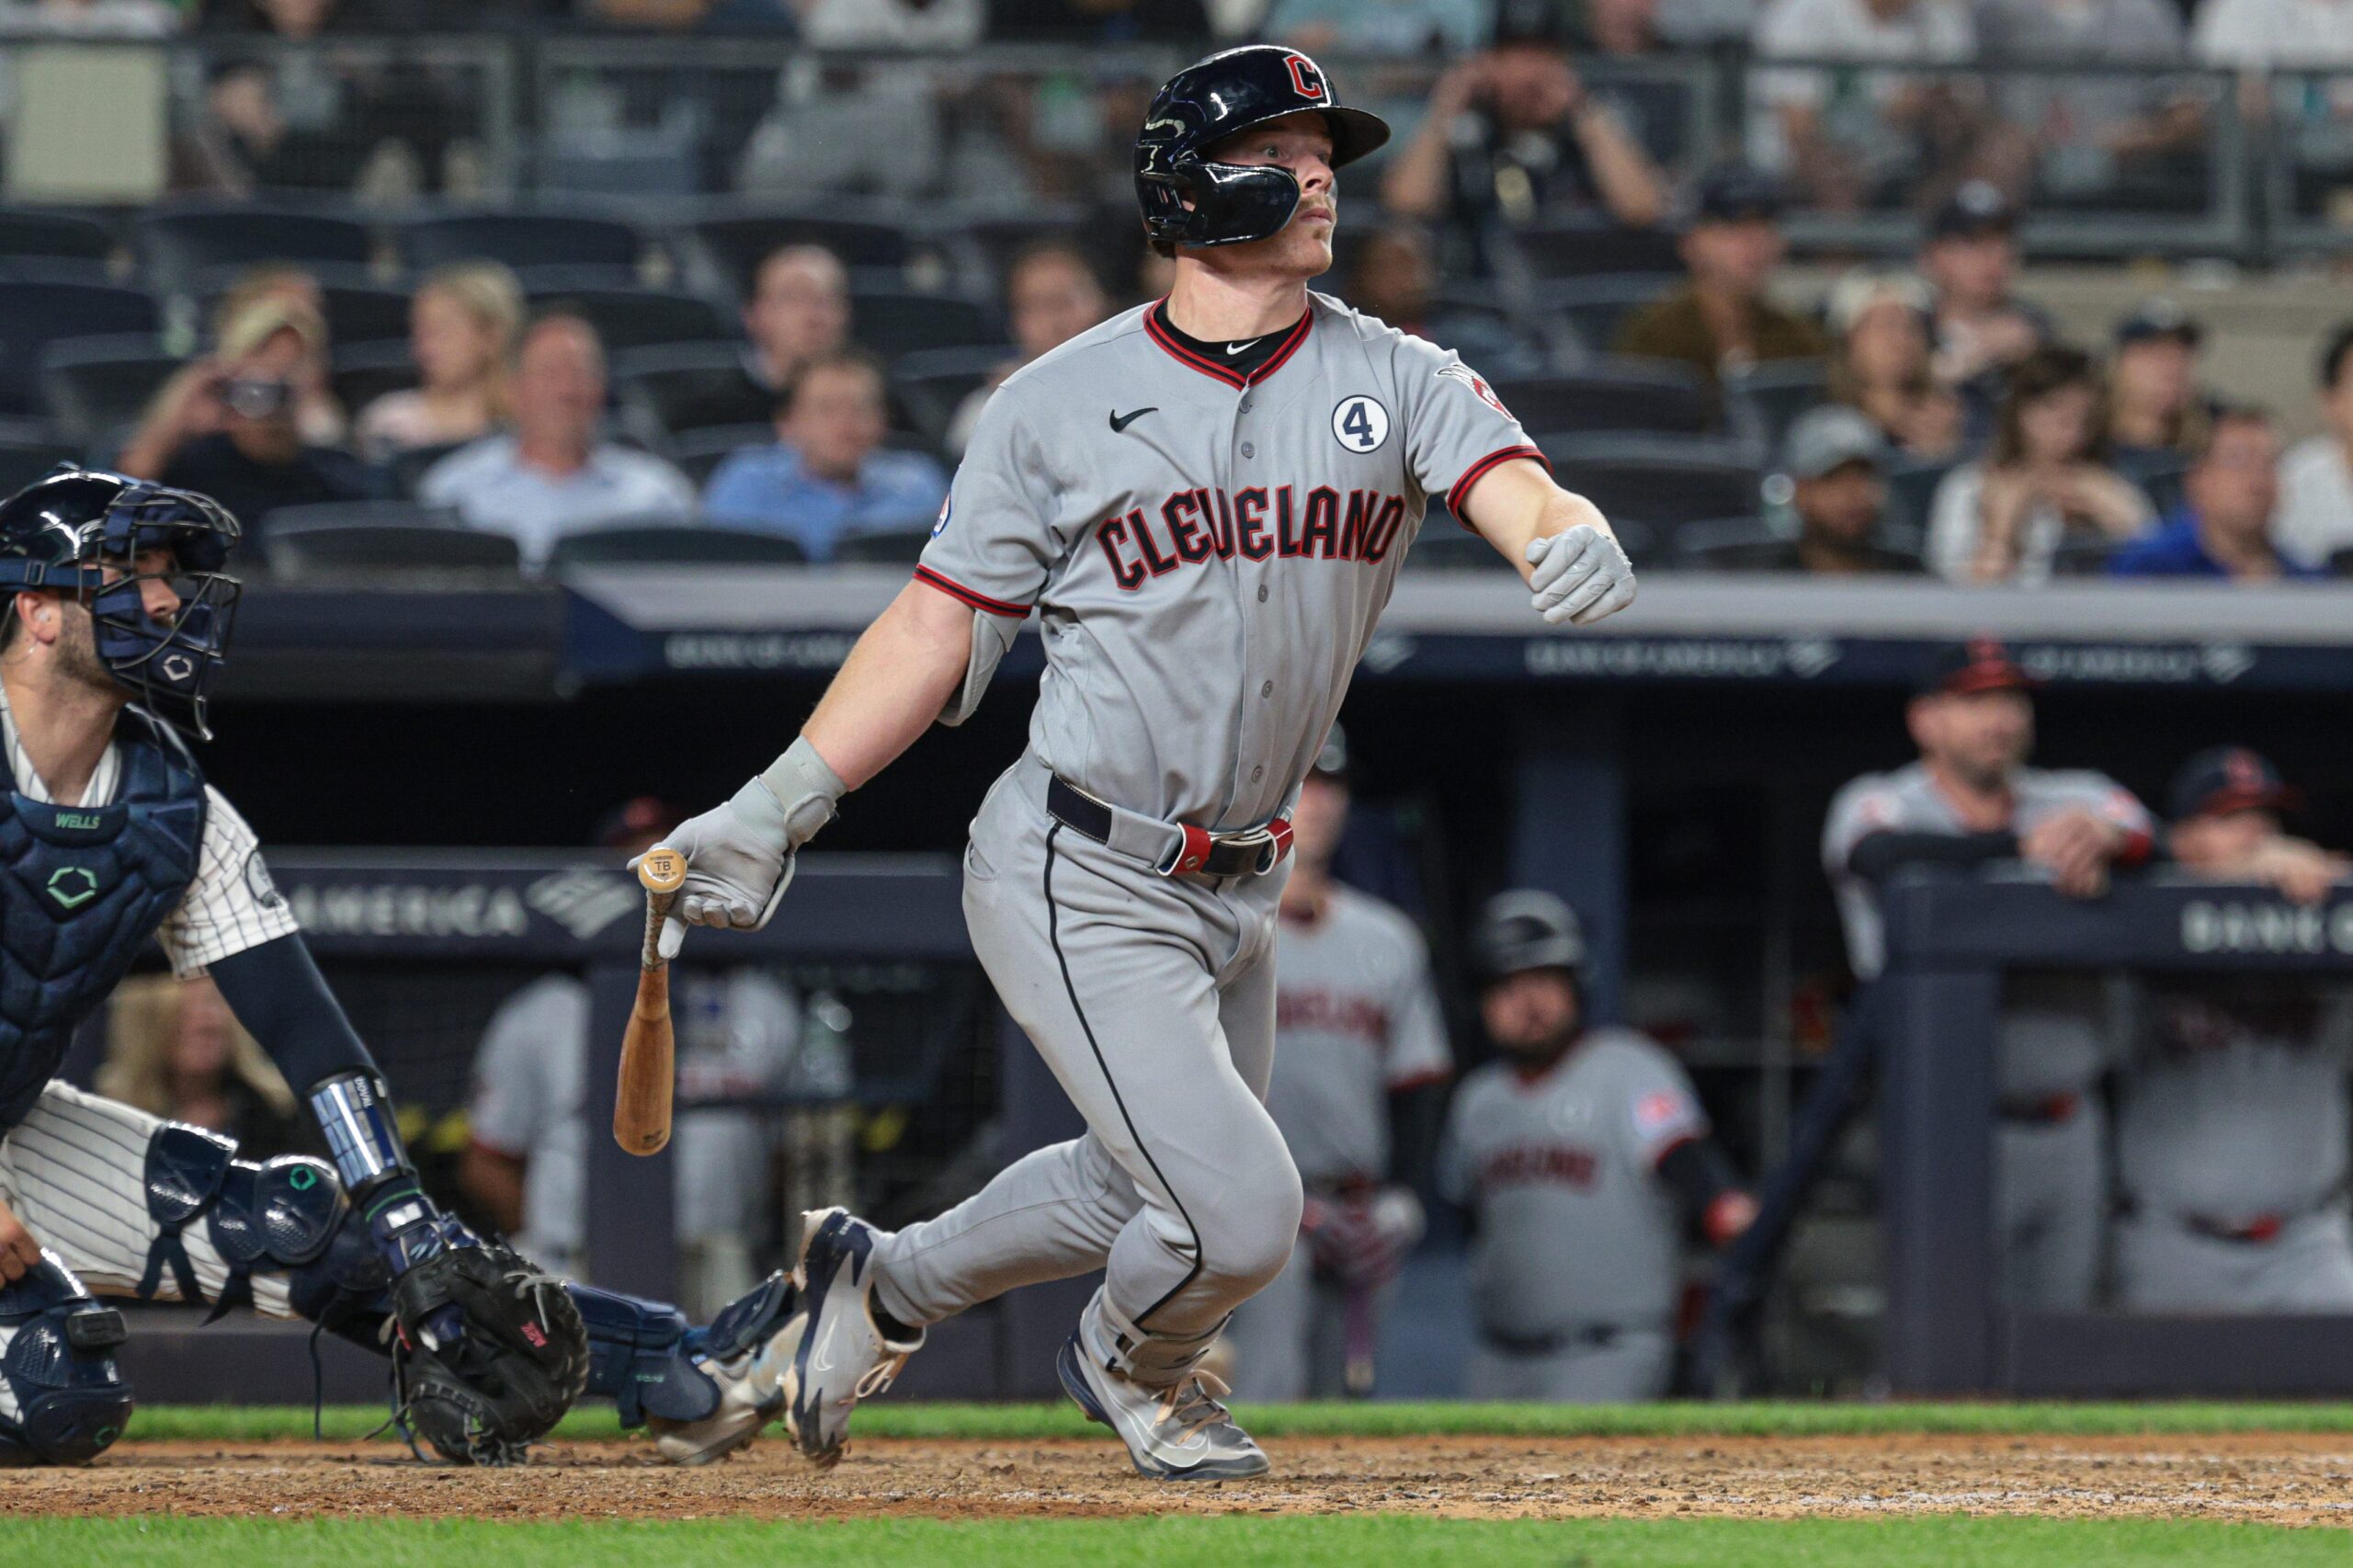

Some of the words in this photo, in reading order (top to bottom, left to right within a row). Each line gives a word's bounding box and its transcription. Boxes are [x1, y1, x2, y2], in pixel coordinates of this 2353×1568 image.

[1282, 54, 1324, 99] C
[1342, 402, 1375, 447] 4
[1096, 484, 1406, 591] CLEVELAND
[56, 812, 100, 829] WELLS
[654, 860, 671, 871] TB
[290, 884, 529, 937] AMERICA
